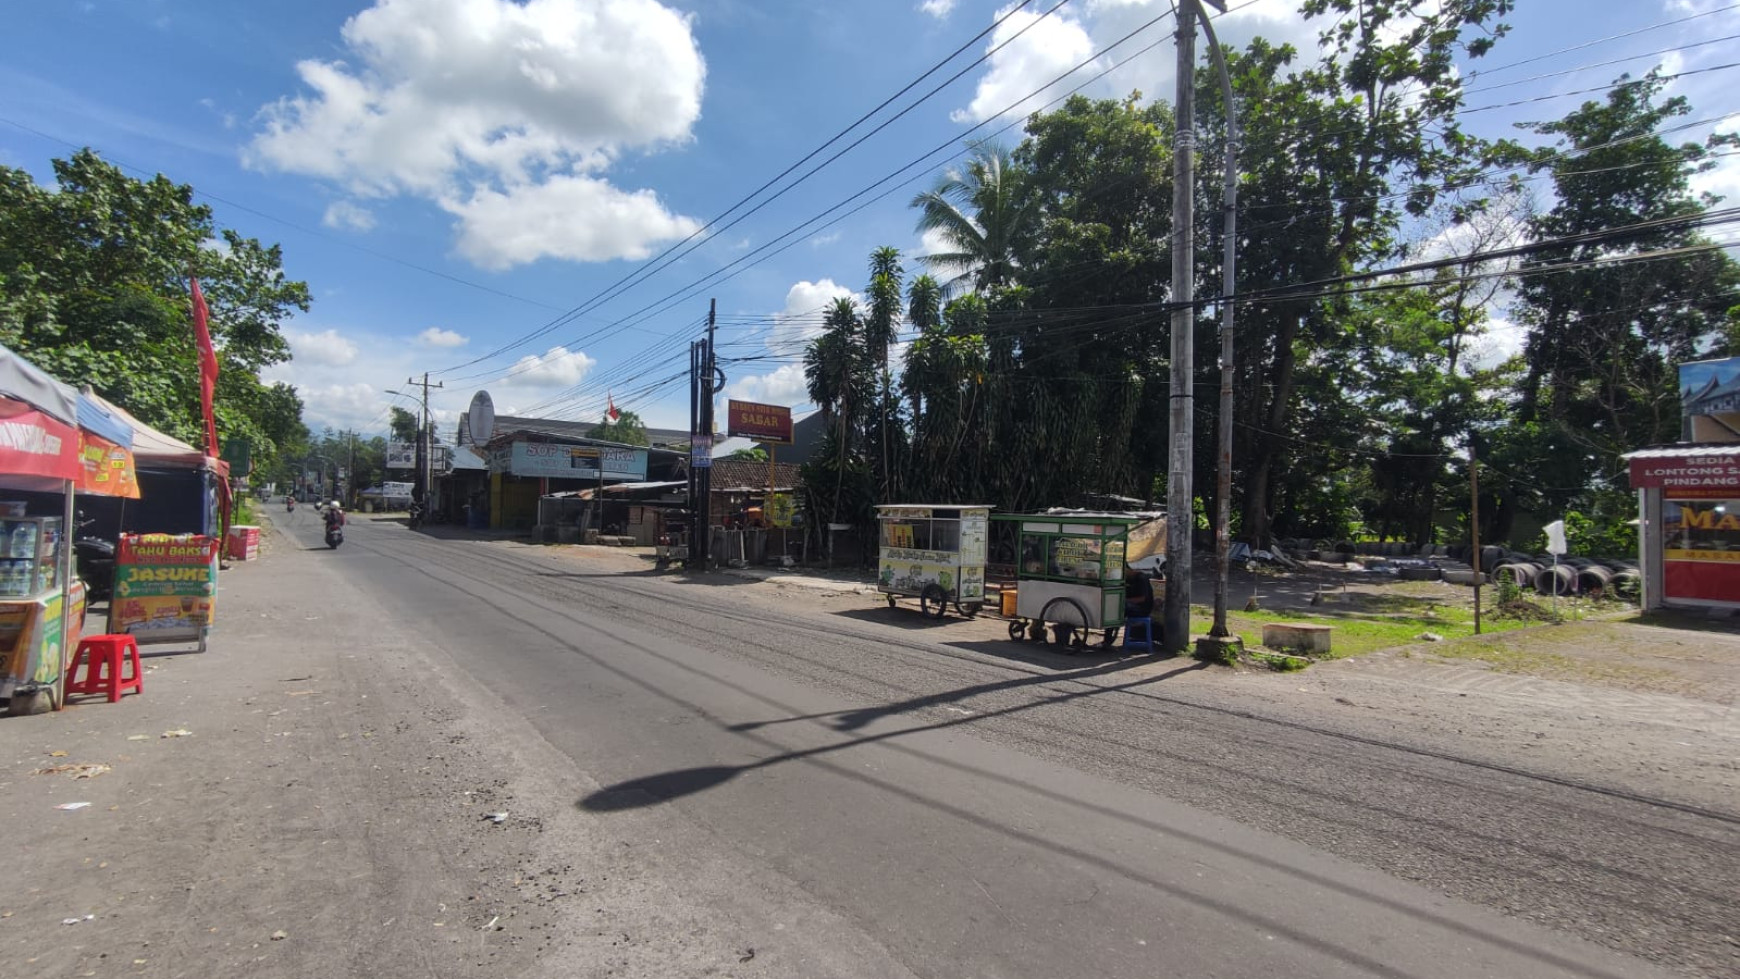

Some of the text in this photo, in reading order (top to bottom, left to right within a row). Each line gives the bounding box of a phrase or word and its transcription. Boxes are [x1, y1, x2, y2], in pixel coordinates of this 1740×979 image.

[741, 412, 778, 427] SABAR
[527, 443, 558, 457] SOP
[1686, 457, 1735, 465] SEDIA
[1645, 467, 1724, 476] LONTONG
[1664, 477, 1738, 485] PINDANG
[131, 545, 165, 556] TAHU
[127, 567, 209, 582] JASUKE
